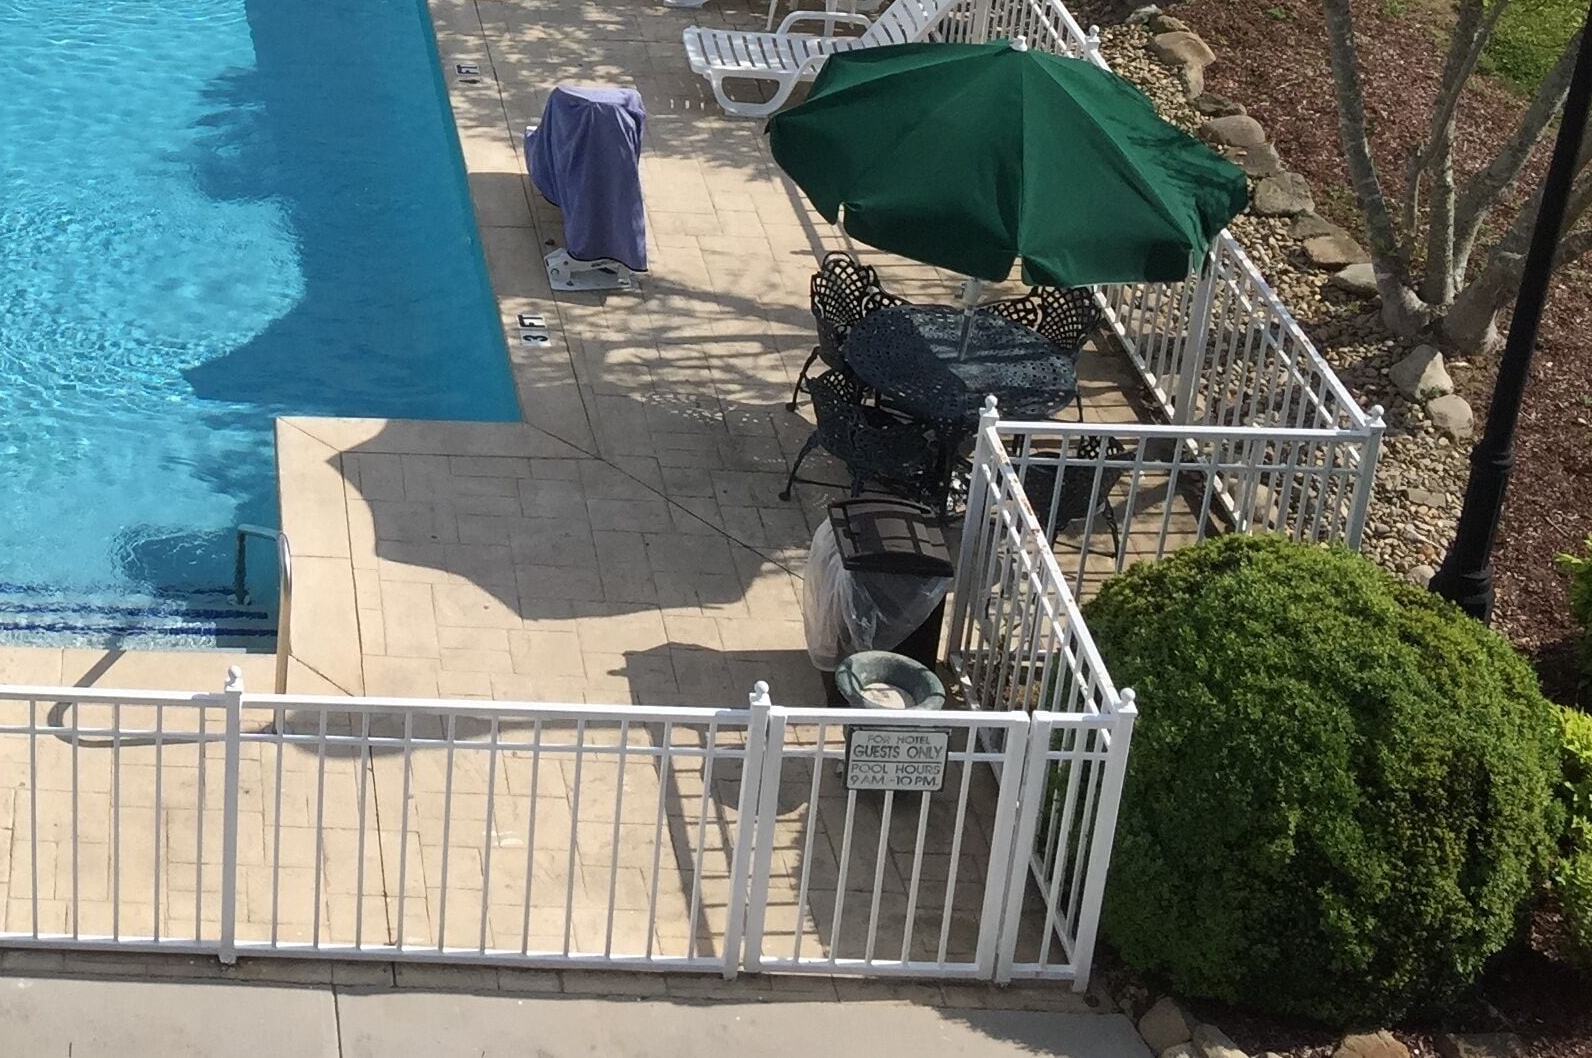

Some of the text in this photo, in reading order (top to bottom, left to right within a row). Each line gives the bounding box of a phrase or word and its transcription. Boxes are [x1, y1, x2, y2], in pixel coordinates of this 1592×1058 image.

[456, 64, 480, 75] FT
[518, 314, 546, 329] FT
[867, 734, 931, 745] FOR HOTEL
[853, 744, 943, 760] GUESTS ONLY
[851, 763, 941, 775] POOL HOURS
